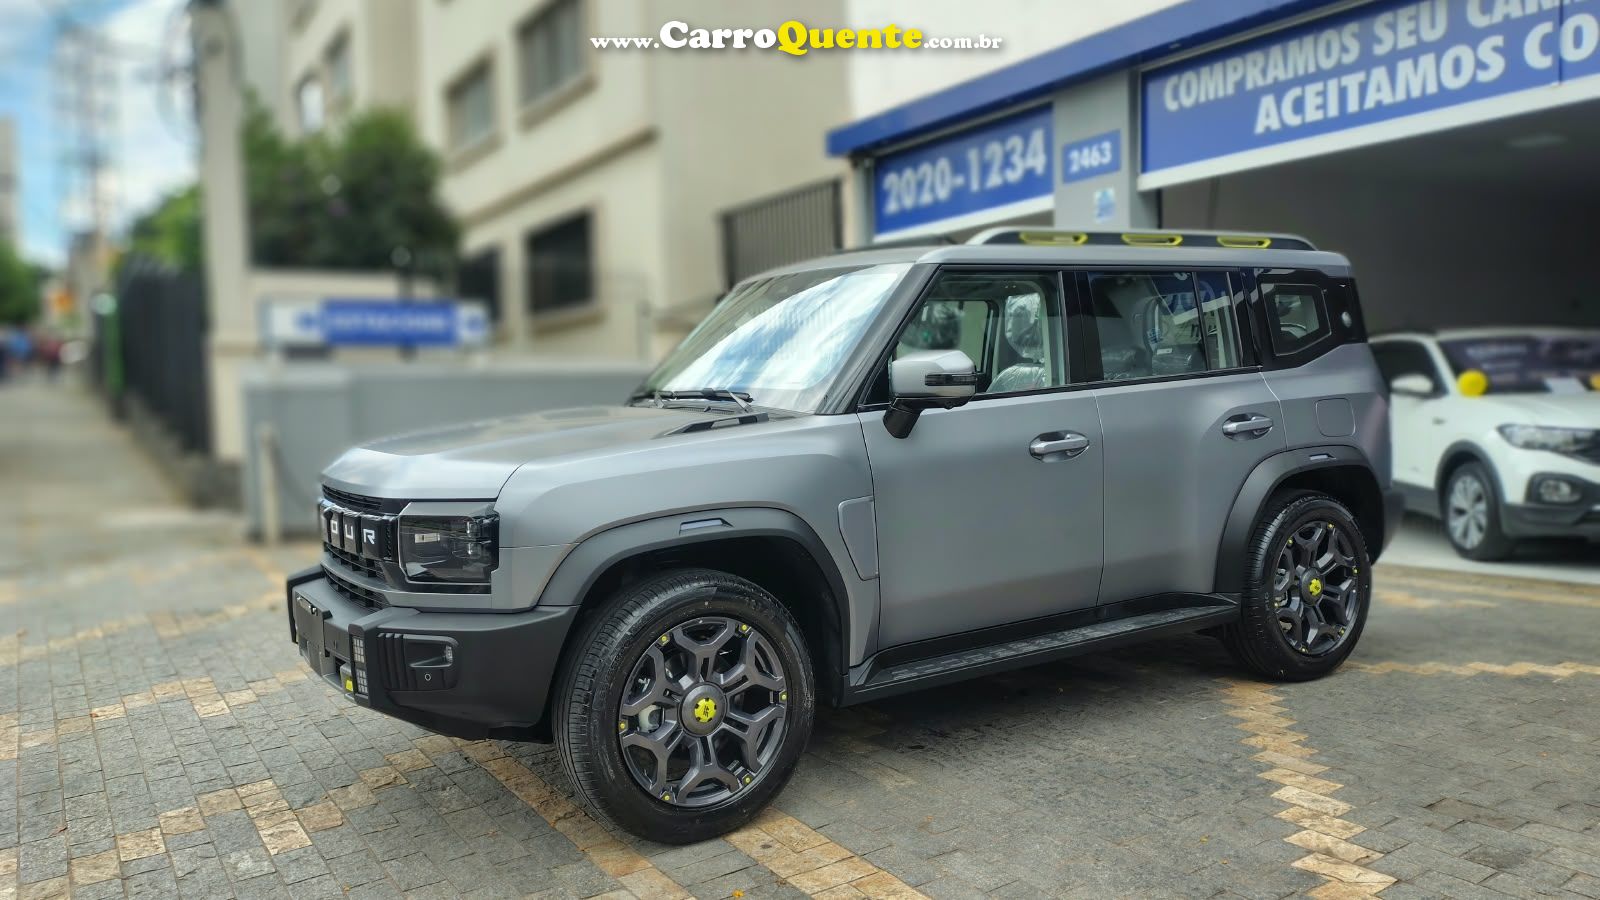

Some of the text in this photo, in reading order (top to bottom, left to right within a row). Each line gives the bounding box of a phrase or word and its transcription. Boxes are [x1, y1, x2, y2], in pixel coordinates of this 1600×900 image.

[1164, 22, 1361, 112] COMPRAMOS
[1373, 0, 1449, 56] SEU
[1254, 35, 1505, 135] ACEITAMOS
[882, 128, 1047, 216] 2020-1234
[1068, 141, 1113, 174] 2463
